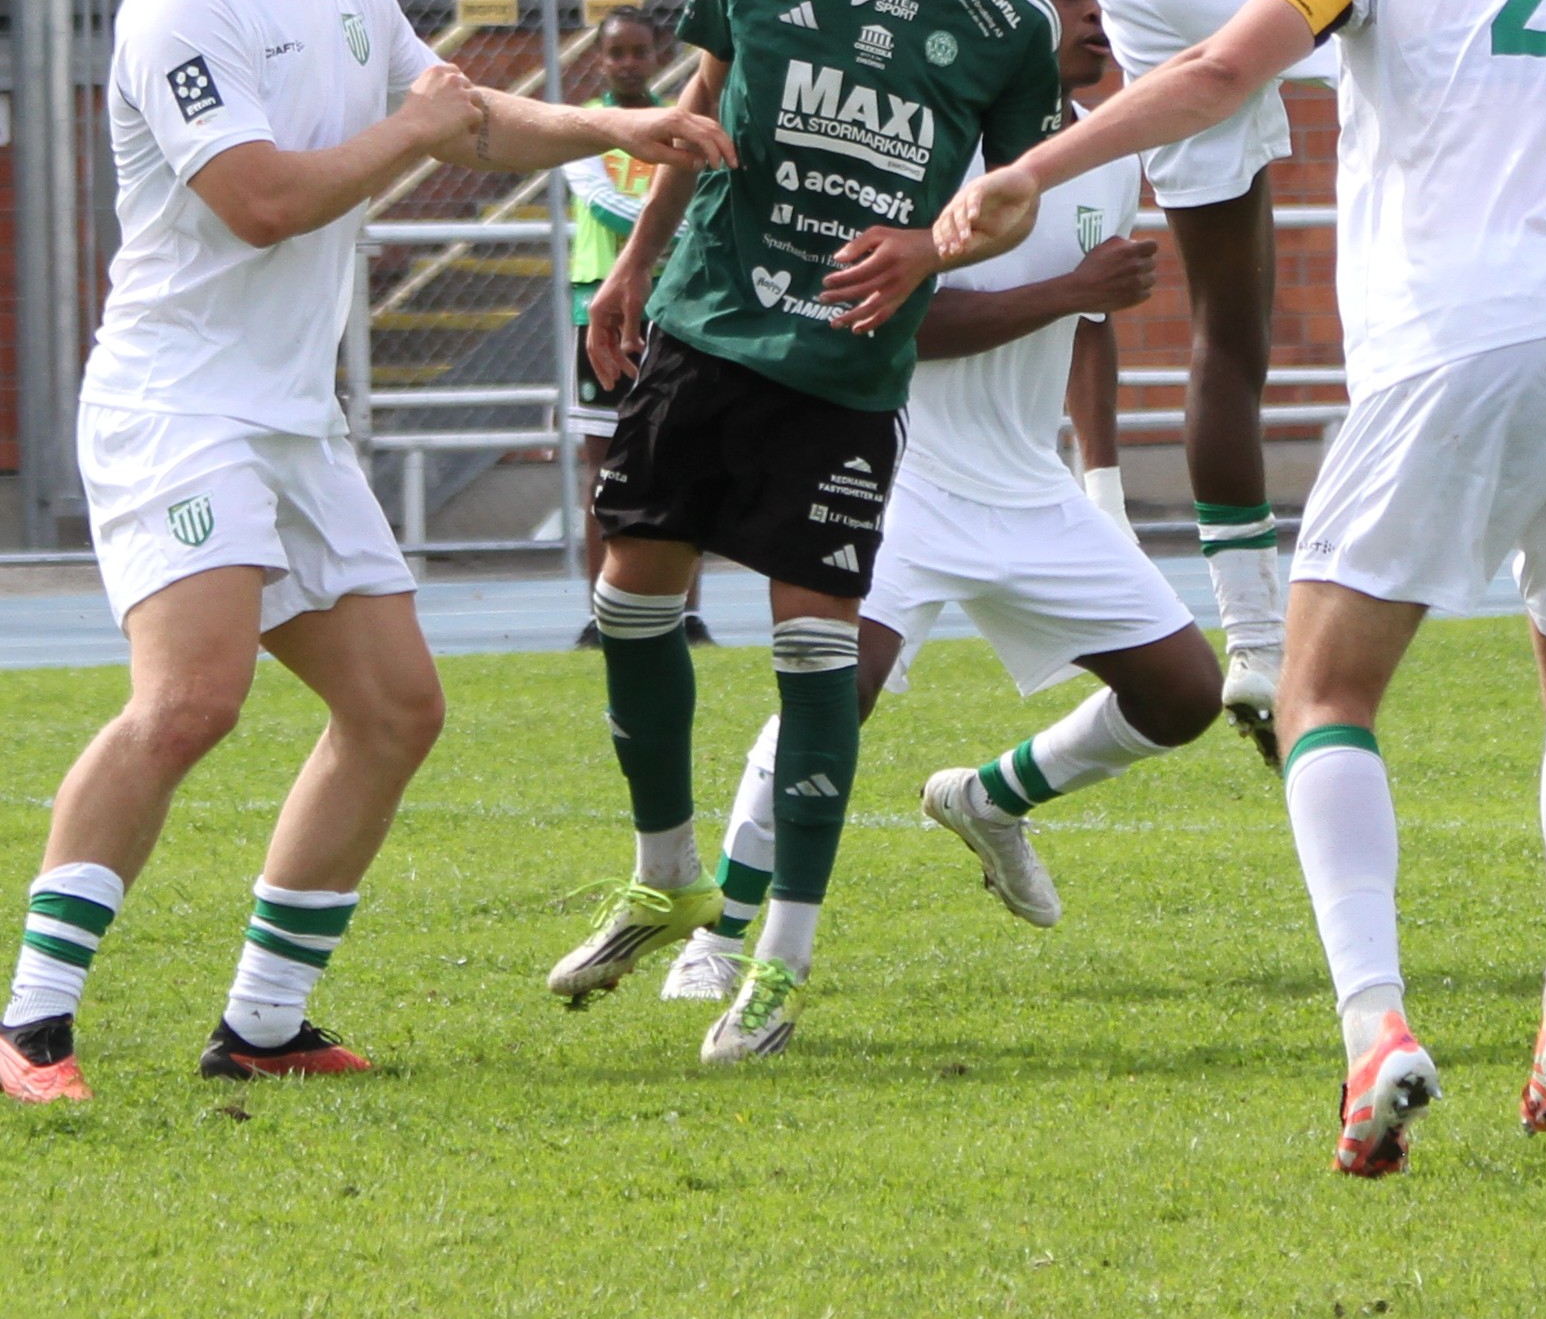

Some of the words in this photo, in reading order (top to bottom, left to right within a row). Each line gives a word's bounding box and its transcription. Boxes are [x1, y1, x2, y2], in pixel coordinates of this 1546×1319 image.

[875, 1, 917, 21] SPORT
[781, 59, 935, 149] MAXI
[777, 111, 804, 130] ICA
[807, 117, 930, 164] STORMARKNAD
[804, 171, 914, 225] accesit
